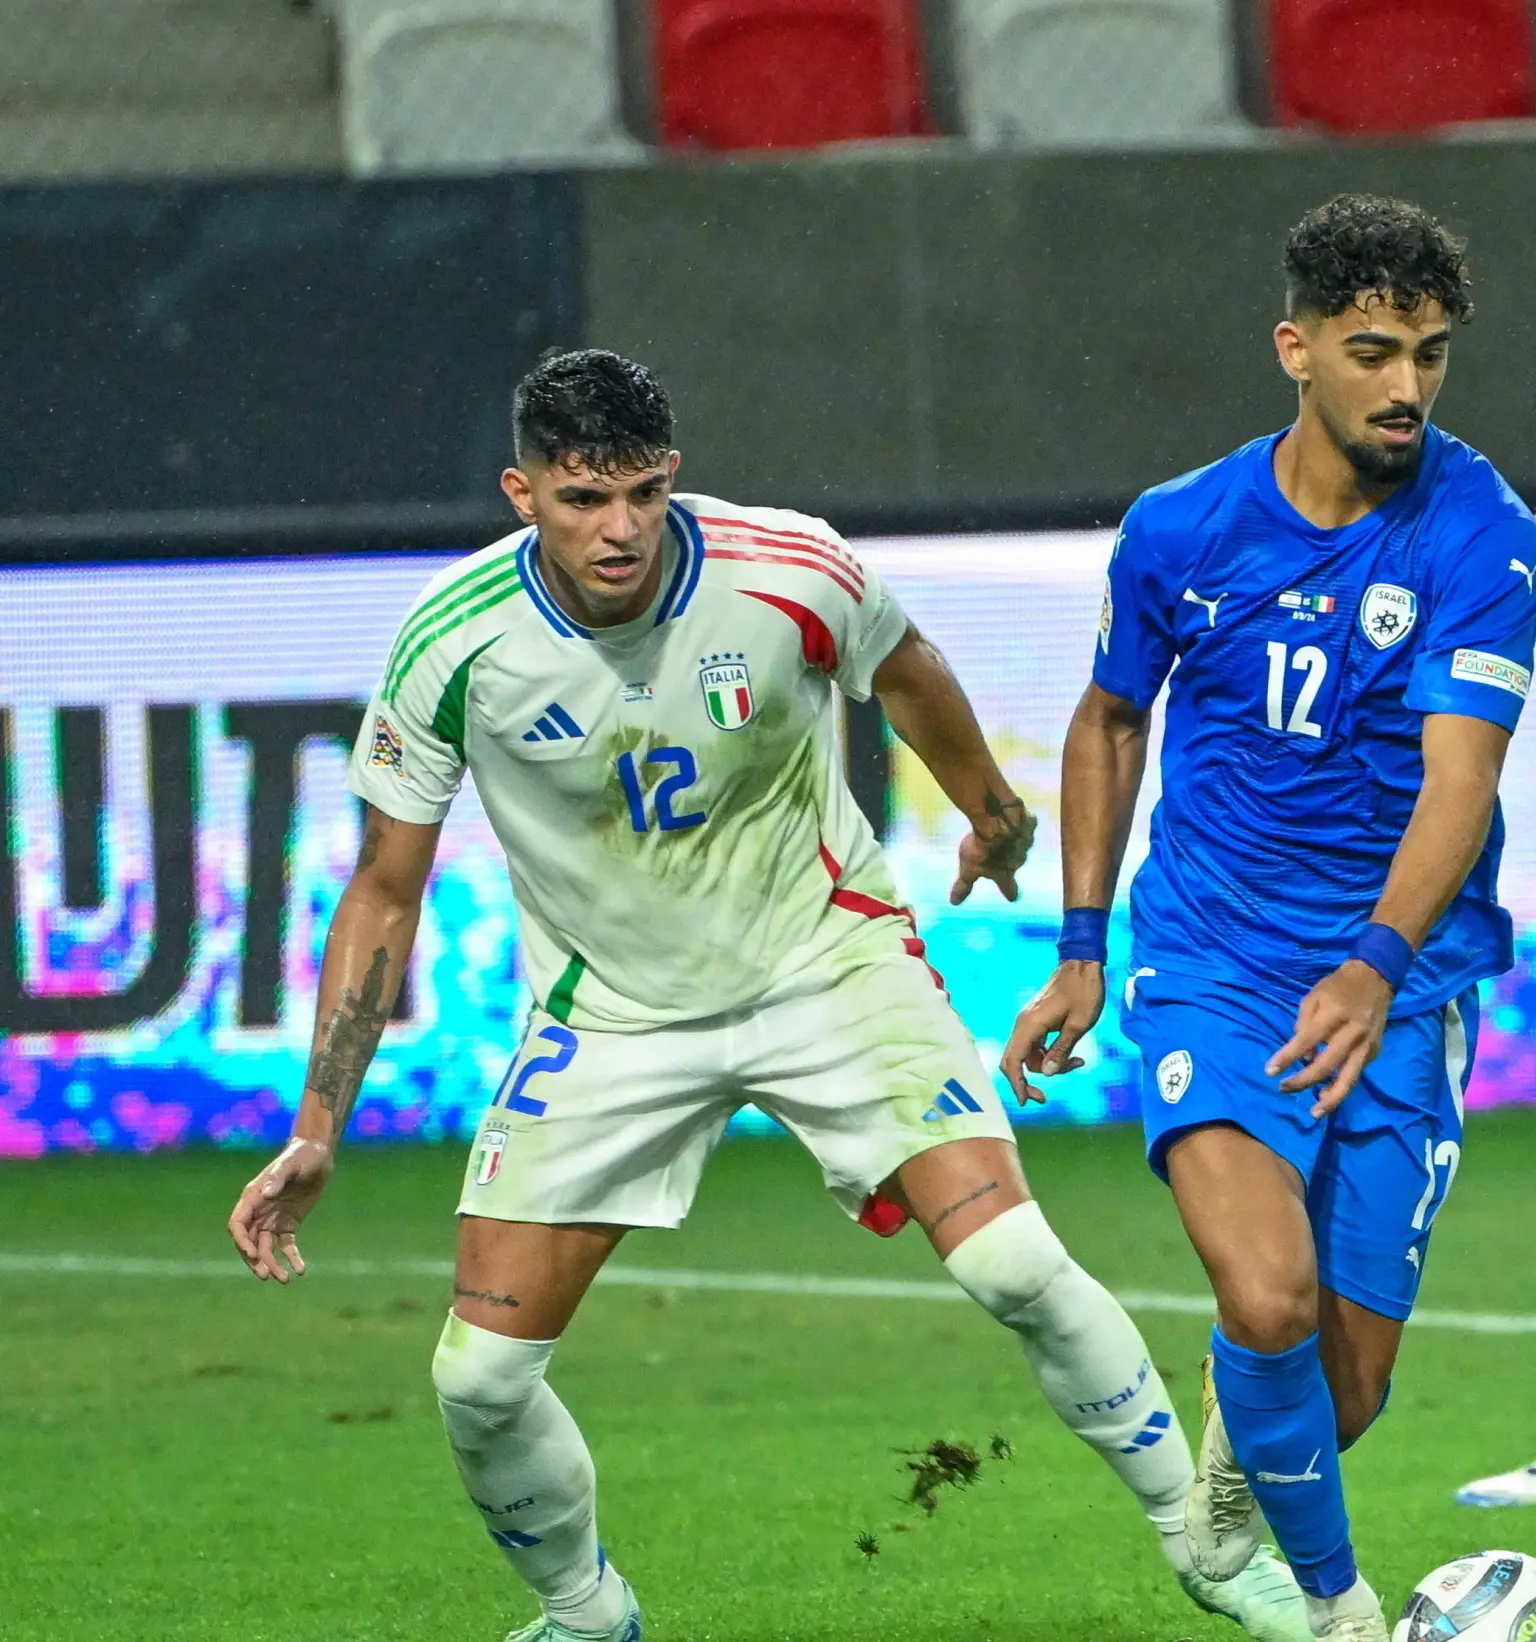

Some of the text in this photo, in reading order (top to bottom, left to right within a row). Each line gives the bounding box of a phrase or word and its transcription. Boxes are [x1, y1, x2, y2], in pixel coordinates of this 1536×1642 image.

[1375, 590, 1408, 606] ISRAEL
[704, 669, 745, 685] ITALIA
[1266, 641, 1327, 738] 12
[617, 746, 707, 832] 12
[1411, 1138, 1460, 1231] 12
